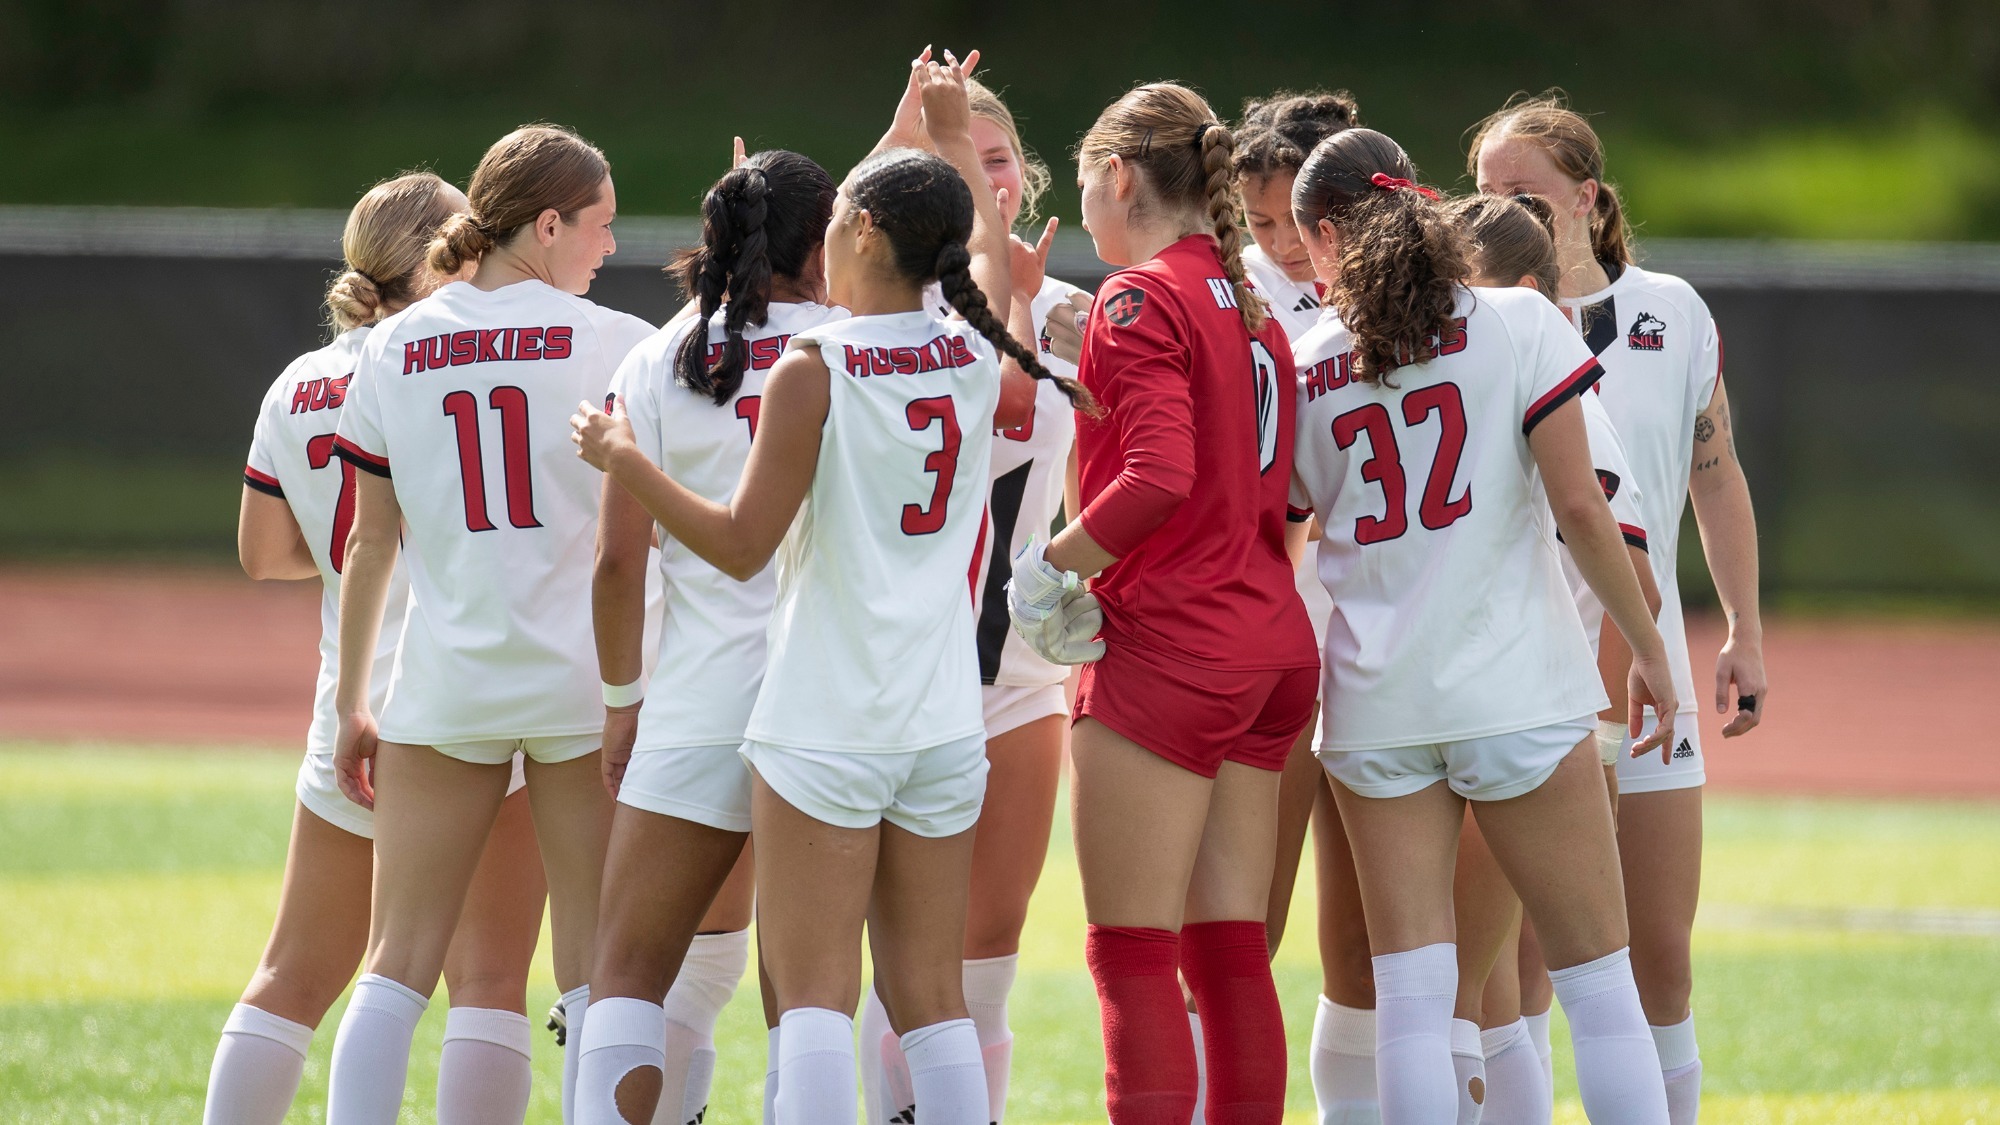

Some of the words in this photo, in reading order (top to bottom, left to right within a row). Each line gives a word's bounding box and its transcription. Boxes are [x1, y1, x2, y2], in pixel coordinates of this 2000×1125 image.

[403, 326, 574, 375] HUSKIES
[1628, 335, 1664, 347] NIU
[290, 372, 355, 414] HUS
[442, 385, 544, 532] 11
[900, 394, 963, 536] 3
[1331, 381, 1473, 546] 32
